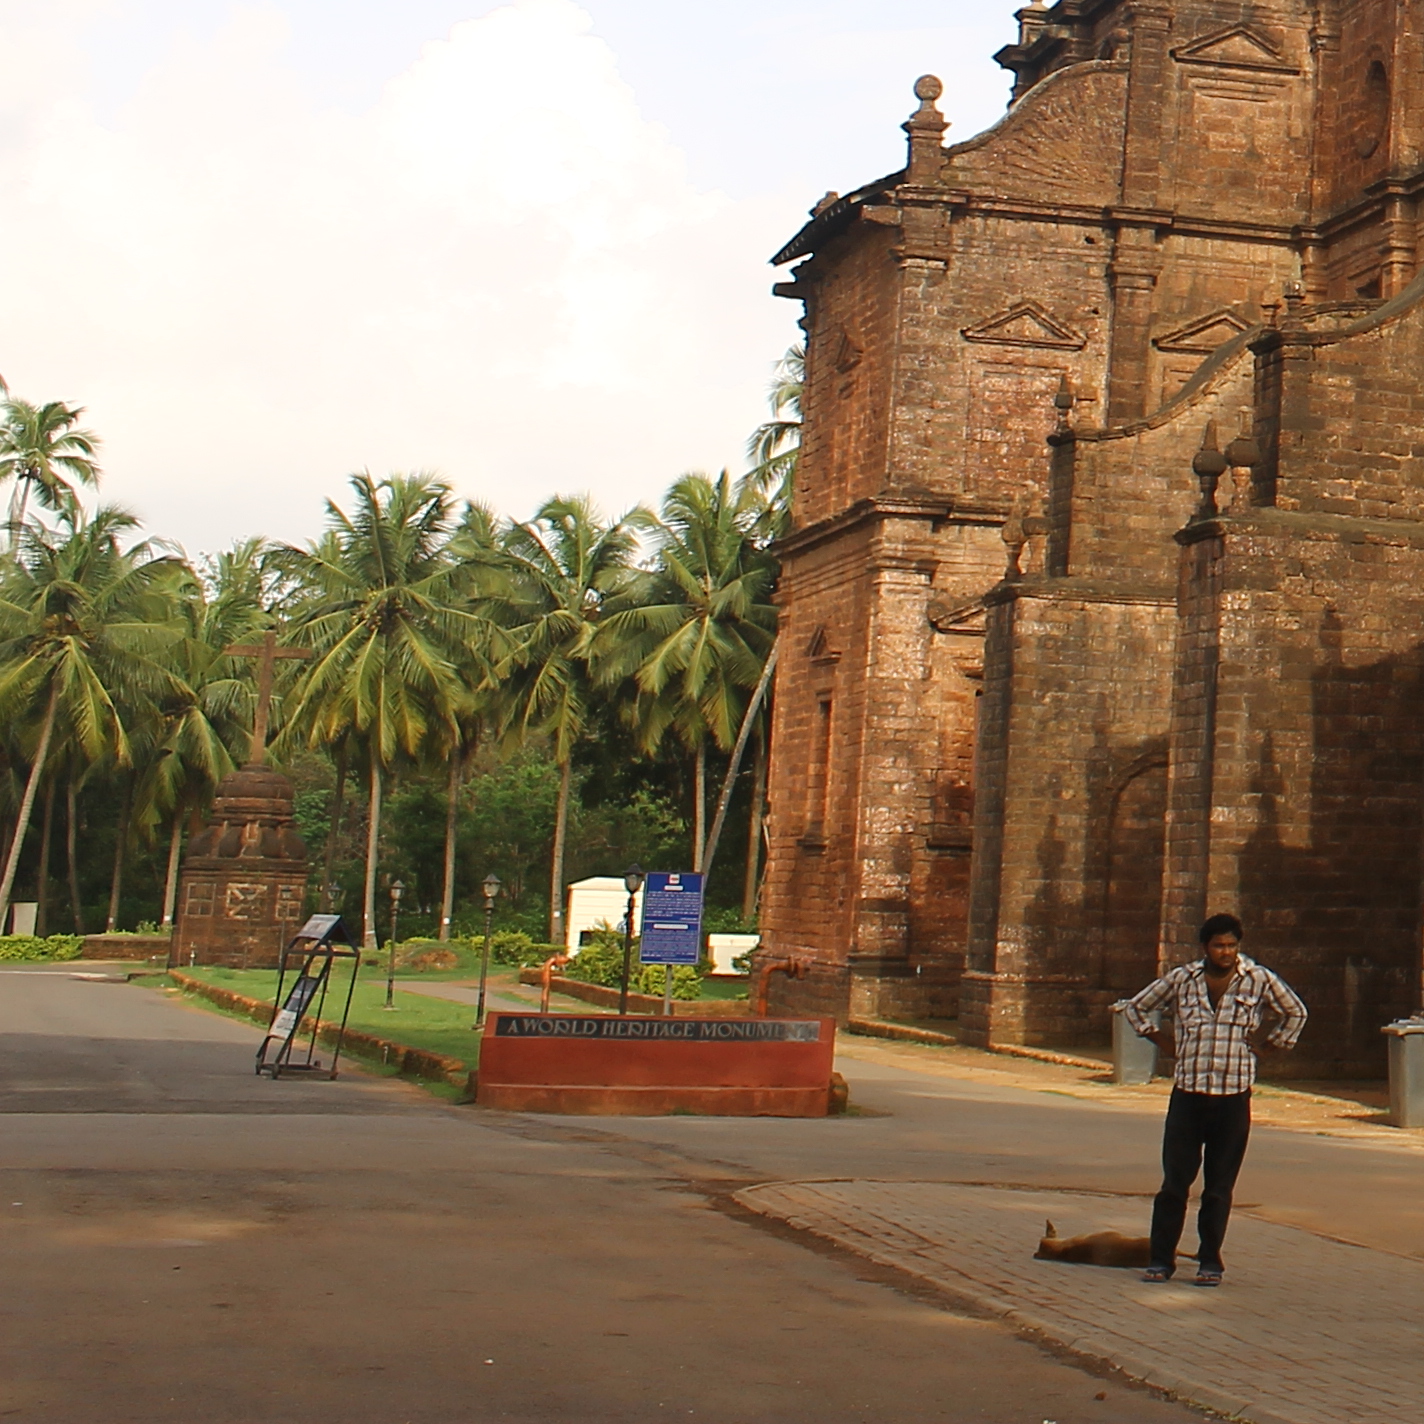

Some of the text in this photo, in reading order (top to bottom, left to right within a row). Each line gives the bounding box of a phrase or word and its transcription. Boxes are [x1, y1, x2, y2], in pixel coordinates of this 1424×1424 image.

[507, 1020, 519, 1034] A
[523, 1018, 597, 1036] WORLD
[602, 1021, 694, 1038] HERITAGE
